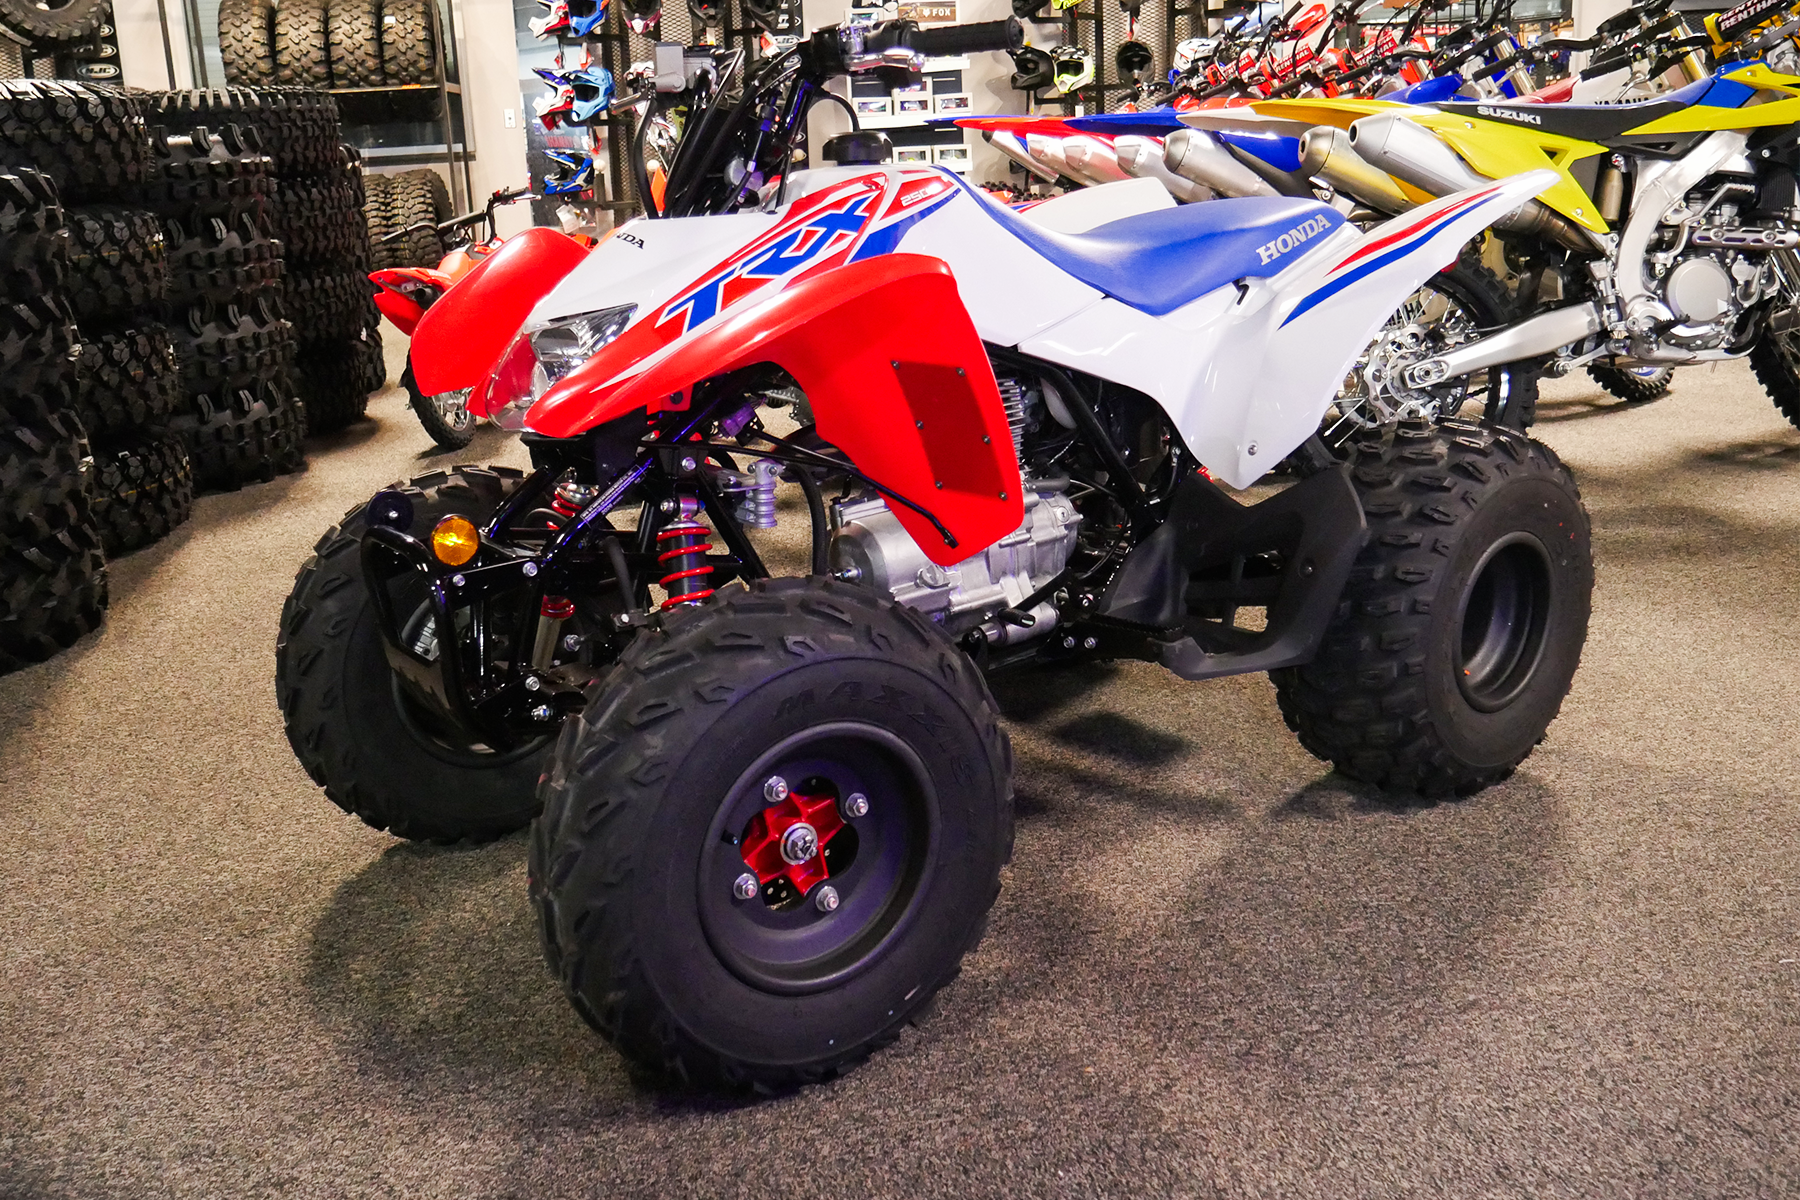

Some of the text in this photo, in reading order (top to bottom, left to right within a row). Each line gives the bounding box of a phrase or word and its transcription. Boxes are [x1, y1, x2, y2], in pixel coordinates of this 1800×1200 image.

[932, 8, 951, 17] FOX
[1720, 0, 1779, 31] RENTHA
[1356, 41, 1394, 67] RENHAL
[1477, 106, 1542, 125] SUZUKI
[616, 232, 645, 249] NDA
[1255, 213, 1332, 266] HONDA
[656, 190, 881, 334] TRX
[772, 680, 974, 787] MAXXIS
